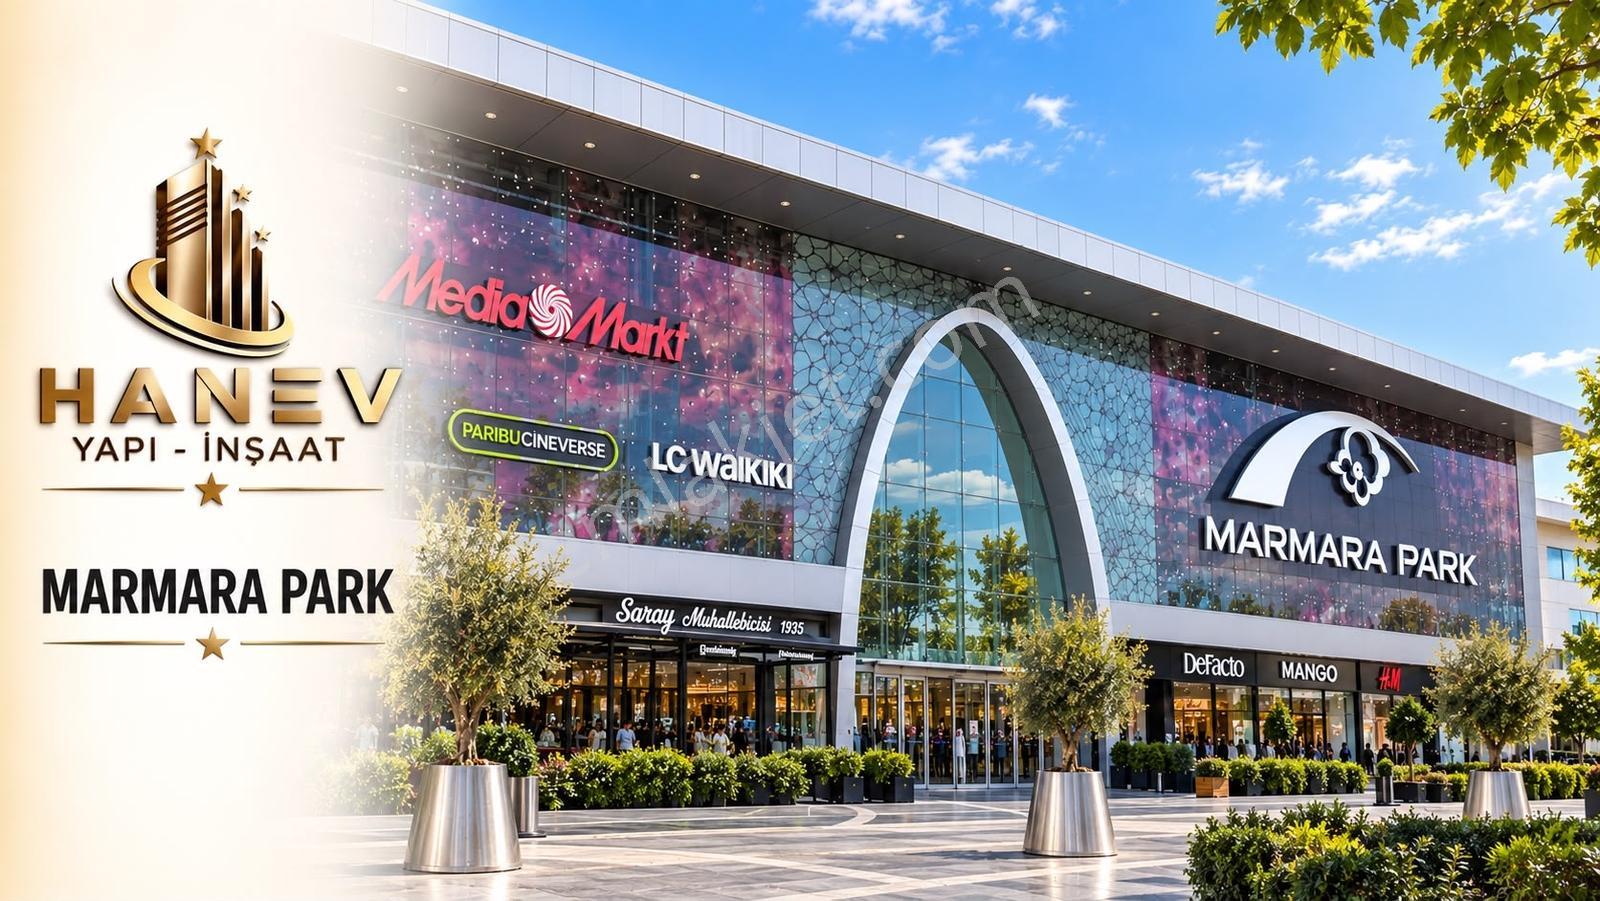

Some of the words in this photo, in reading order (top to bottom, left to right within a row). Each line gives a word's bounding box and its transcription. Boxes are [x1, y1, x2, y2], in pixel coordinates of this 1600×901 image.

[652, 441, 688, 474] LC
[1205, 515, 1388, 574] MARMARA
[1398, 543, 1478, 586] PARK
[615, 597, 676, 635] Saray
[682, 606, 772, 633] Muhallebicisi
[780, 620, 805, 635] 1935
[1184, 652, 1245, 678] DeFacto
[1281, 660, 1338, 683] MANGO
